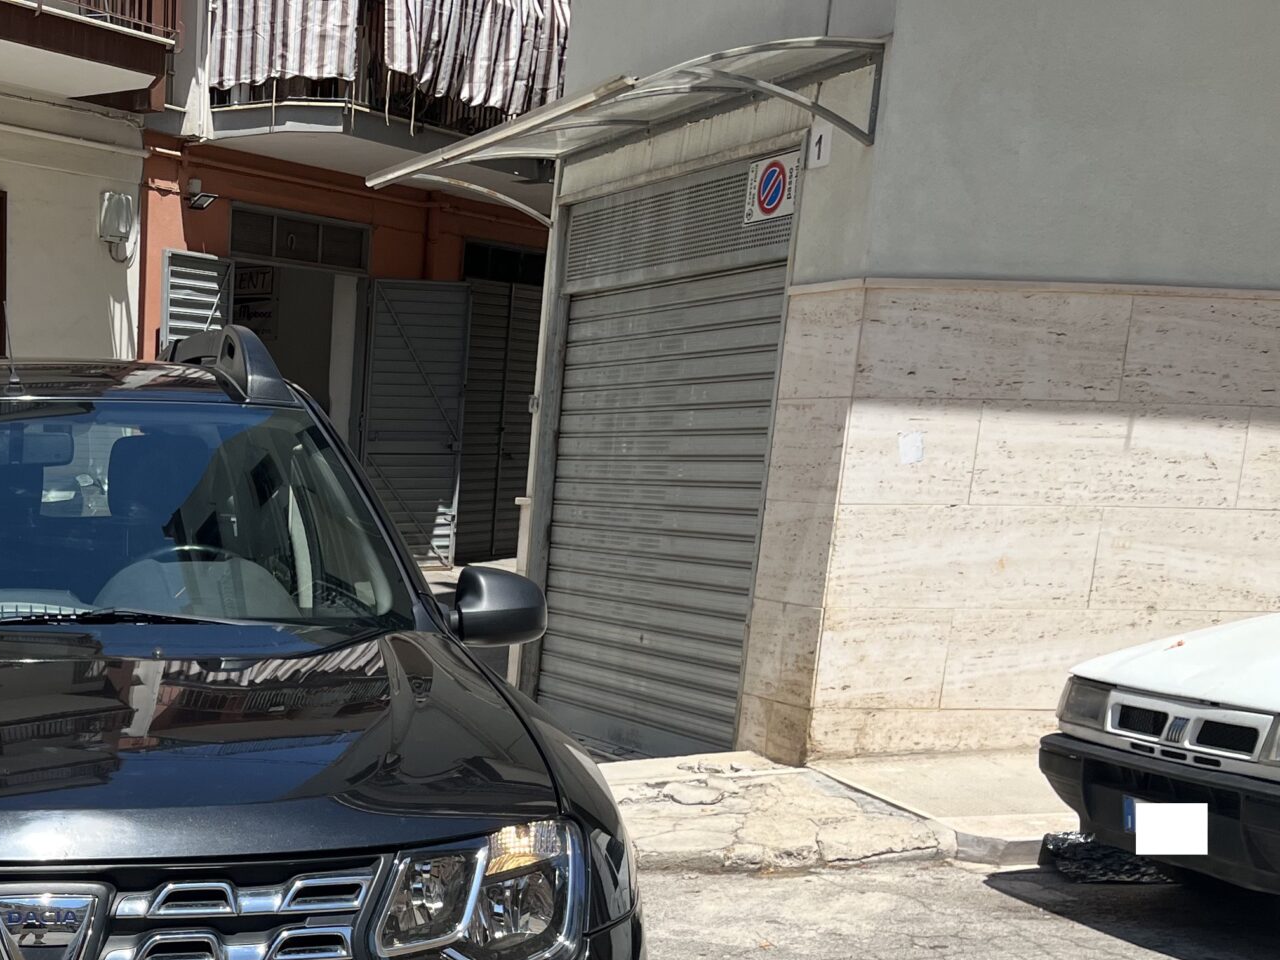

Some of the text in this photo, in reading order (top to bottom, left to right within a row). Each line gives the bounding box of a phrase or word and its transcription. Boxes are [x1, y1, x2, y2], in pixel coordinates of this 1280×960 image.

[814, 134, 823, 160] 1
[235, 270, 272, 289] ENT
[6, 910, 80, 925] DACIA
